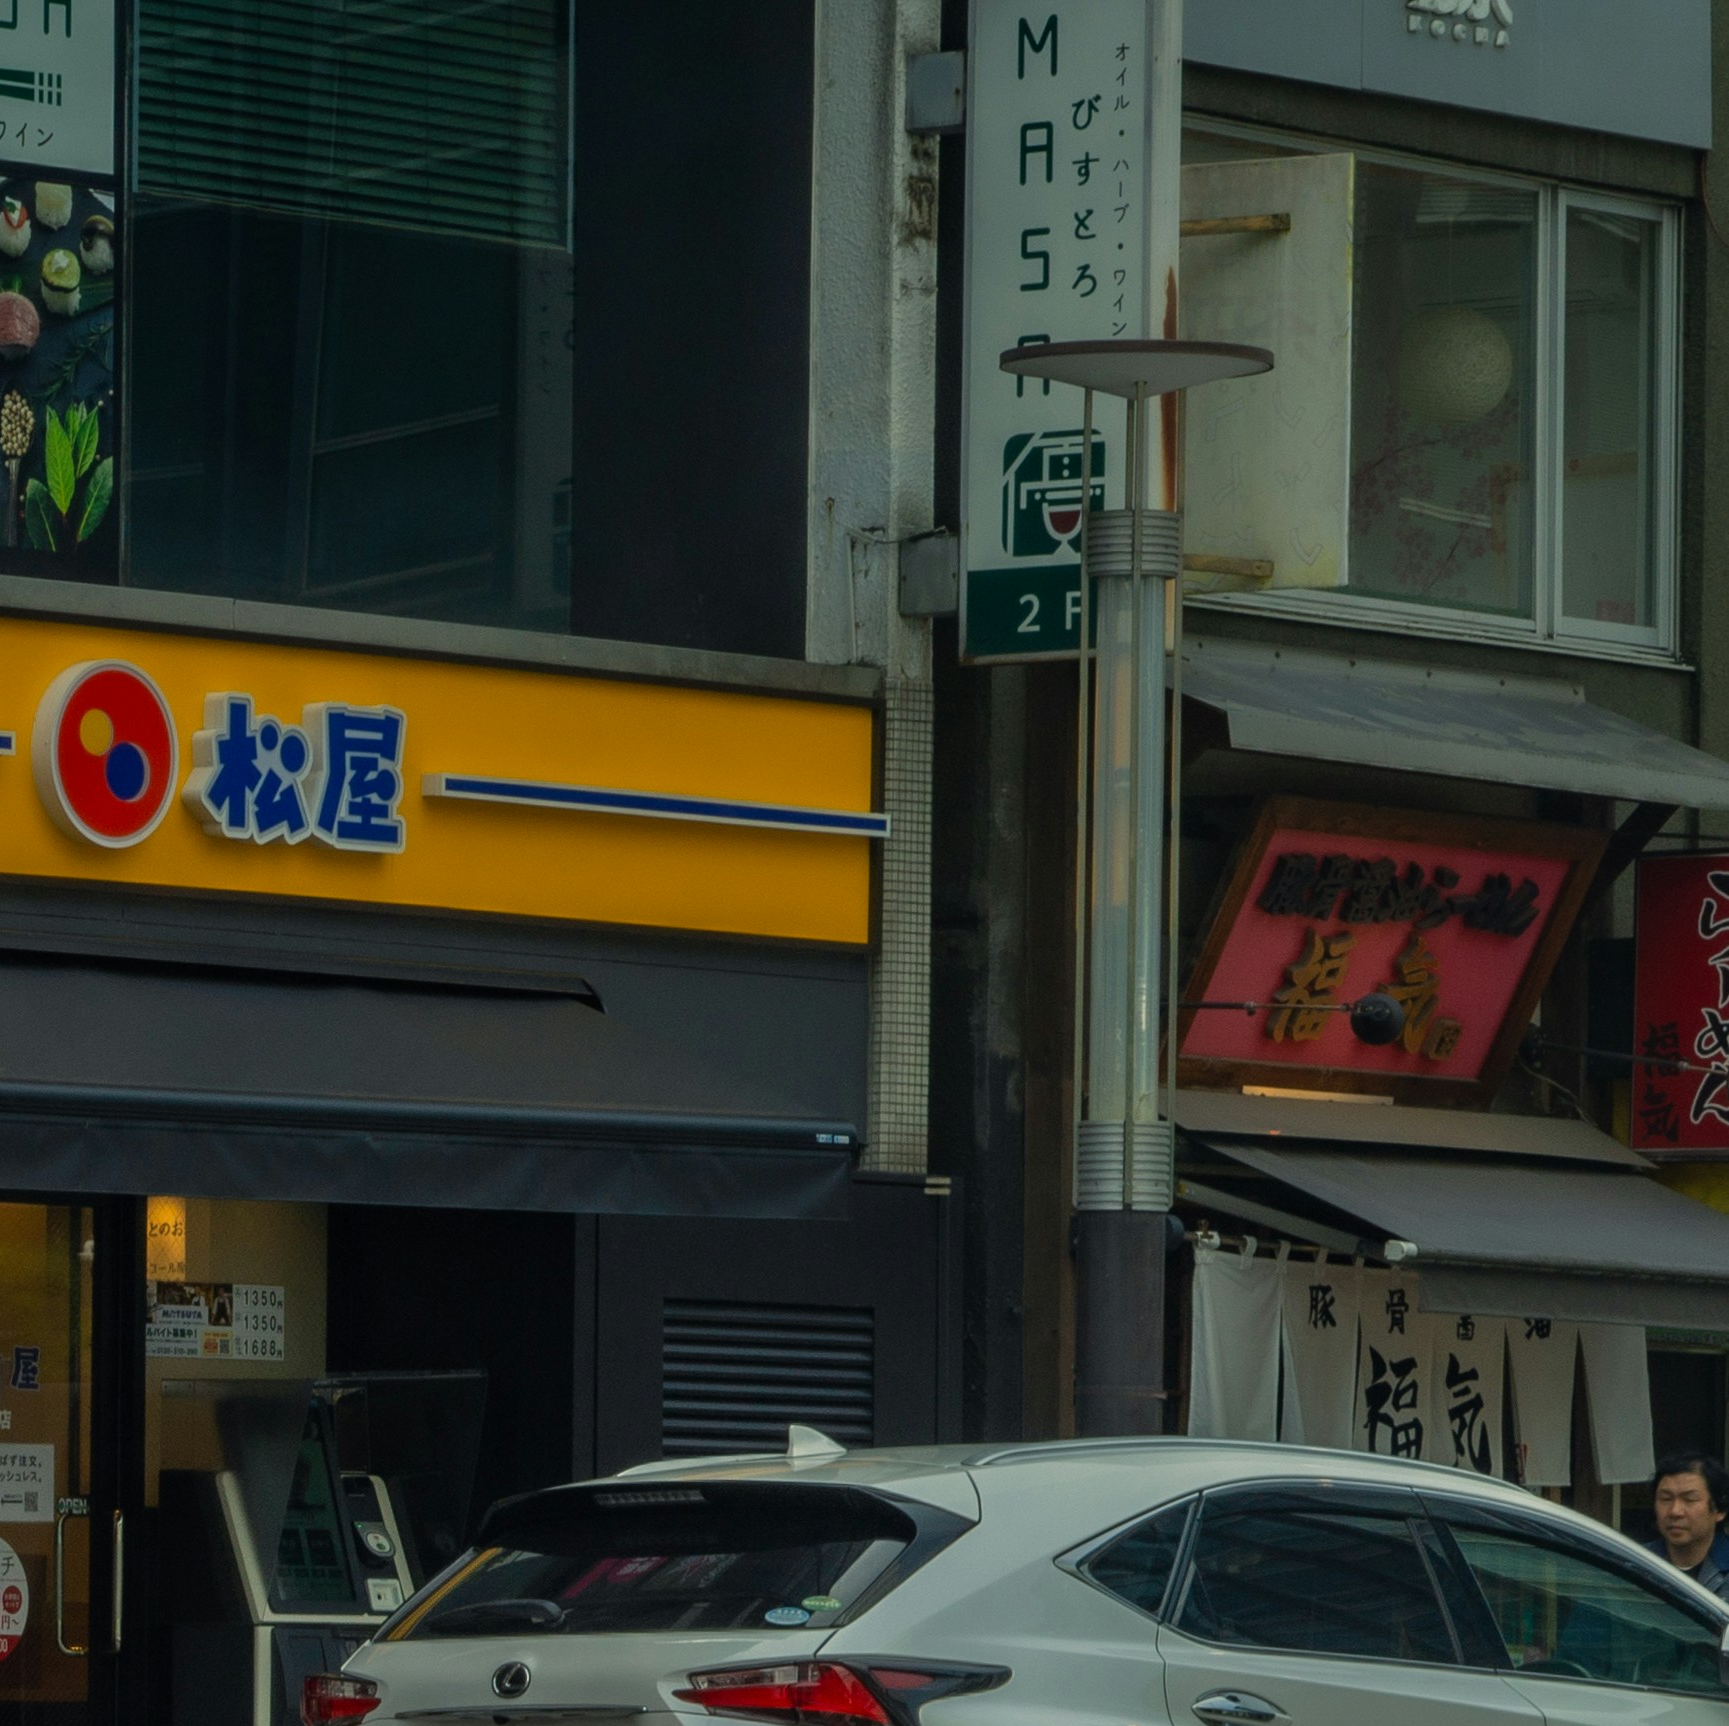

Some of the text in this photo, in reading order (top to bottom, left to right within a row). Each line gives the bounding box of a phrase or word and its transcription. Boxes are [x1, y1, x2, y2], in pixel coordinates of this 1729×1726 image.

[1071, 94, 1102, 298] びすとろ
[199, 694, 406, 852] 松屋
[1364, 1344, 1492, 1475] 福気
